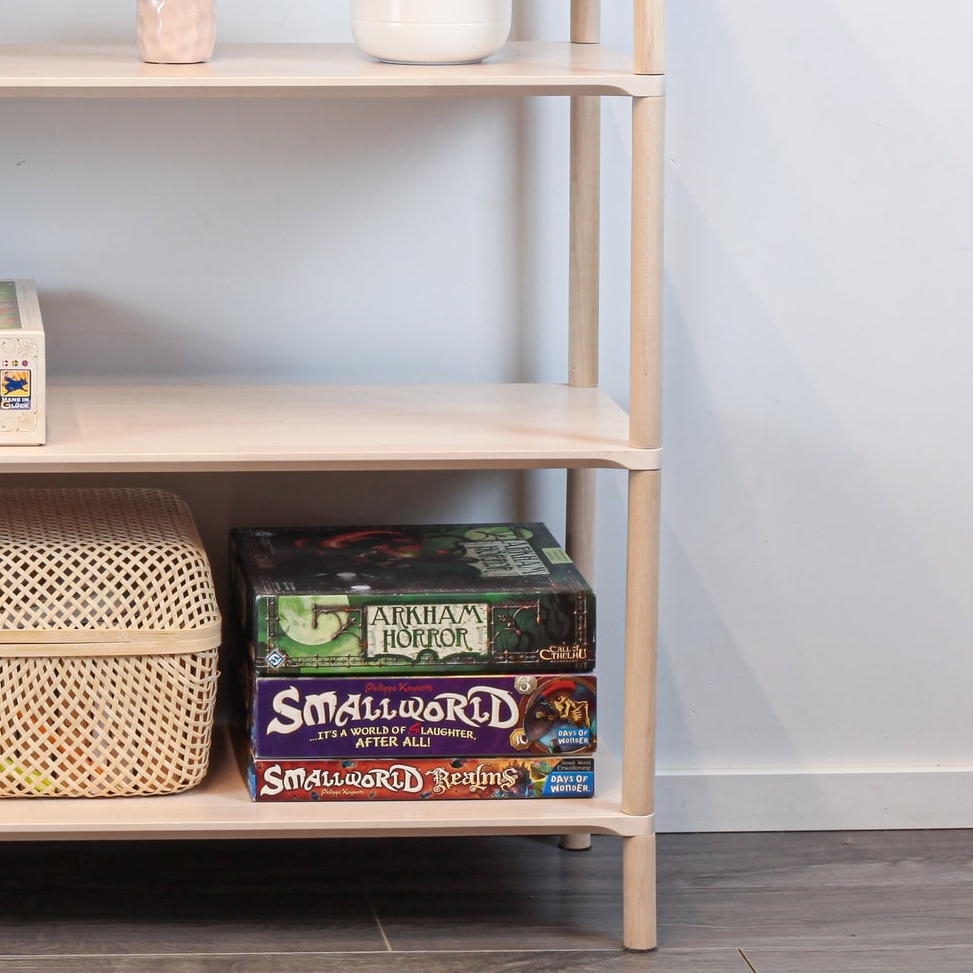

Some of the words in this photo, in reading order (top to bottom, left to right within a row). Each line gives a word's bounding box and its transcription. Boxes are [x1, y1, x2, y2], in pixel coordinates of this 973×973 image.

[370, 605, 483, 629] ARKHAM
[382, 628, 473, 653] HORROR
[539, 648, 587, 661] CTHULHU
[549, 645, 572, 653] CALL
[340, 729, 348, 737] A
[350, 726, 389, 736] WORLD
[391, 726, 406, 735] OF
[355, 737, 398, 748] AFTER
[402, 736, 431, 748] ALL!
[425, 763, 519, 795] Realms
[551, 775, 574, 783] DAYS
[576, 775, 589, 783] OF
[551, 784, 588, 793] WONDER
